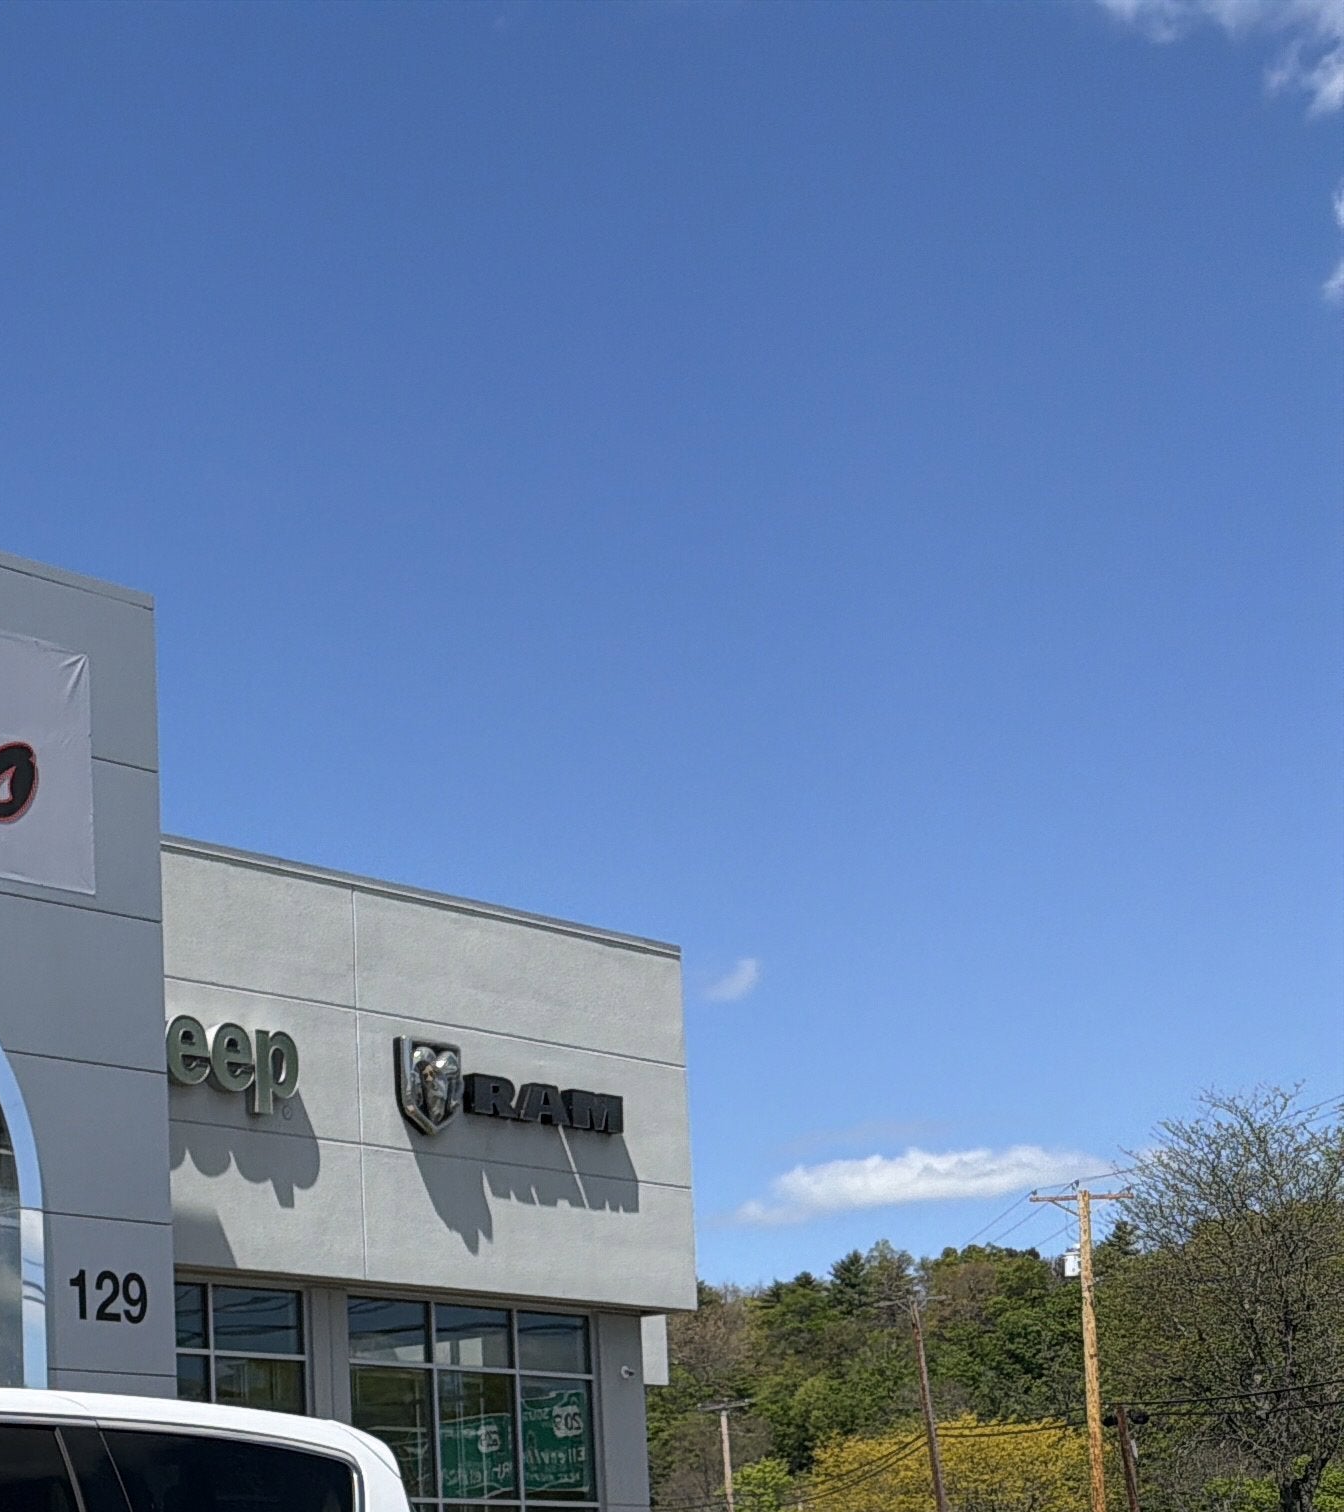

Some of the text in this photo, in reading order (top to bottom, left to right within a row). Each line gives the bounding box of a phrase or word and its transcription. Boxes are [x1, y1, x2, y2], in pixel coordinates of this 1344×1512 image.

[166, 1014, 300, 1115] eep
[462, 1073, 624, 1134] RAM
[69, 1269, 148, 1324] 129
